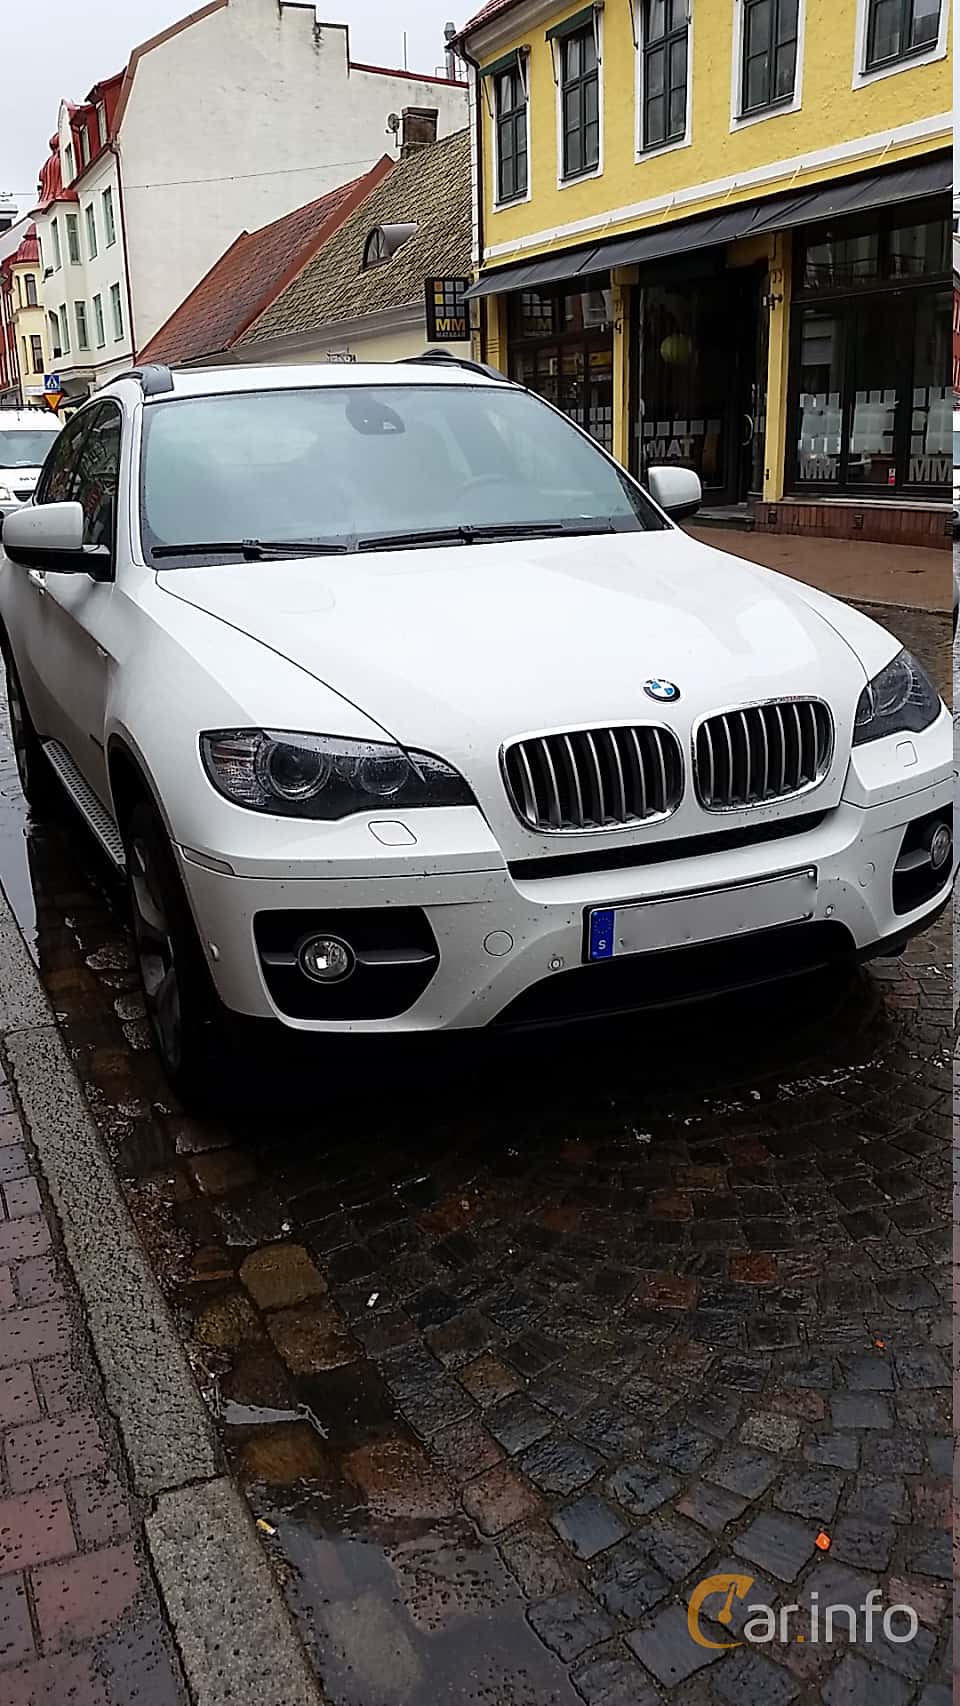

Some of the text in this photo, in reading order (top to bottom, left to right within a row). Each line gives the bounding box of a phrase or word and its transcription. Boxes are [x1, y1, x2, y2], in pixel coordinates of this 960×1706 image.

[435, 318, 465, 331] MM
[648, 439, 695, 458] MAT
[799, 458, 837, 480] MM
[908, 458, 953, 482] MM
[598, 939, 607, 949] S
